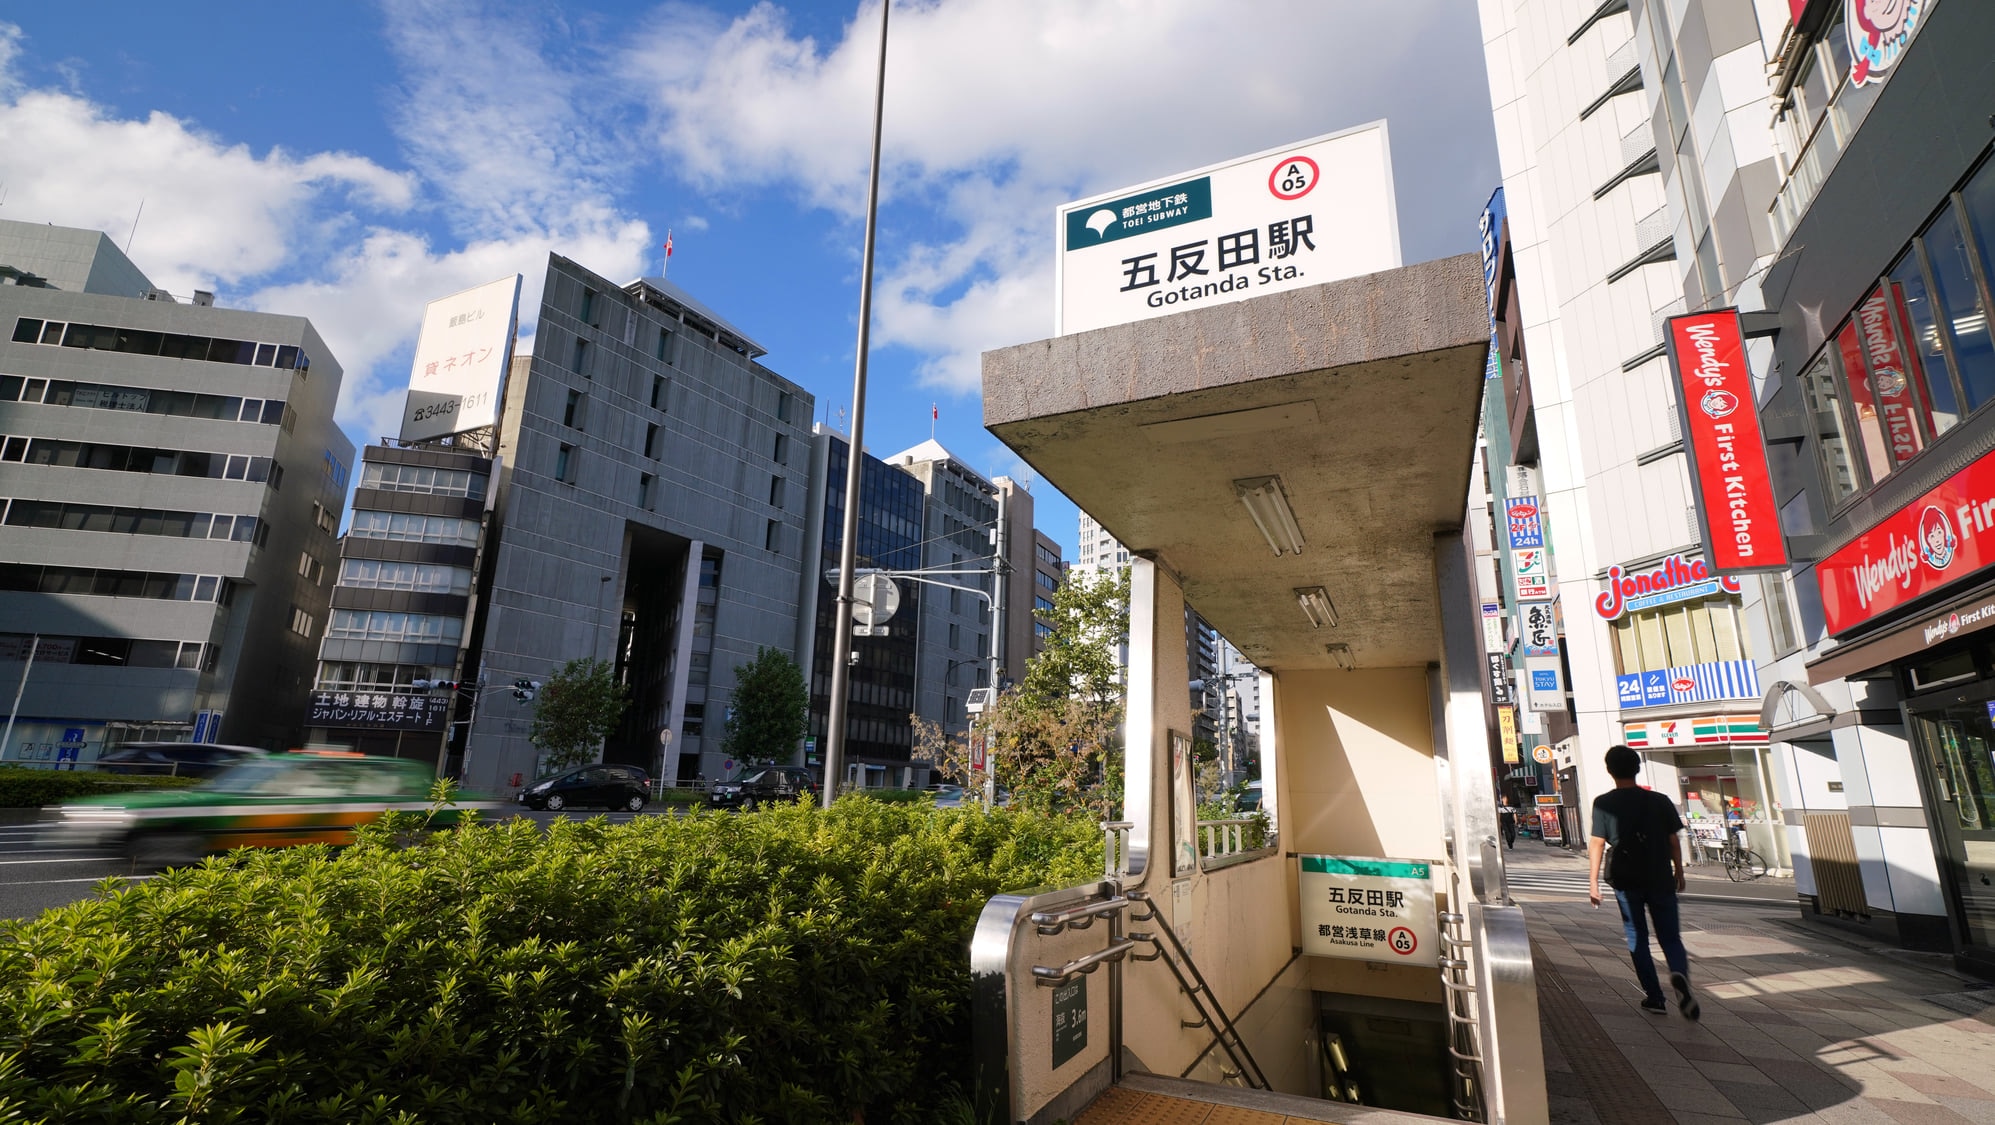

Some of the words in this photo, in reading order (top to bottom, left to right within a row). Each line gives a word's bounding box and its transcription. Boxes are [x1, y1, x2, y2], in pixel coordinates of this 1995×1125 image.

[1287, 164, 1300, 177] A
[1281, 175, 1306, 192] 05
[1122, 192, 1188, 219] 都営地下鉄
[1122, 219, 1144, 230] TOEI
[1147, 206, 1189, 223] SUBWAY
[1120, 214, 1316, 293] 五反田駅
[1147, 273, 1250, 308] Gotanda
[1258, 264, 1305, 286] Sta.
[423, 346, 493, 378] 貸ネオン
[1685, 322, 1730, 388] Wendy's
[424, 391, 488, 420] 3443-1611
[1714, 422, 1741, 472] First
[1724, 476, 1755, 557] Kitchen
[1515, 536, 1539, 547] 24h
[1852, 531, 1919, 610] Wendy's
[1961, 609, 1981, 626] First
[1619, 679, 1640, 695] 24
[1411, 867, 1425, 876] A5
[1328, 887, 1404, 908] 五反田駅
[1335, 904, 1377, 916] Gotanda
[1380, 908, 1398, 918] Sta.
[1318, 924, 1387, 942] 都営浅草線
[1330, 938, 1358, 947] Asakusa
[1360, 940, 1375, 948] Line
[1398, 931, 1406, 940] A
[1395, 939, 1411, 950] 05
[1071, 1008, 1087, 1029] 3.6m
